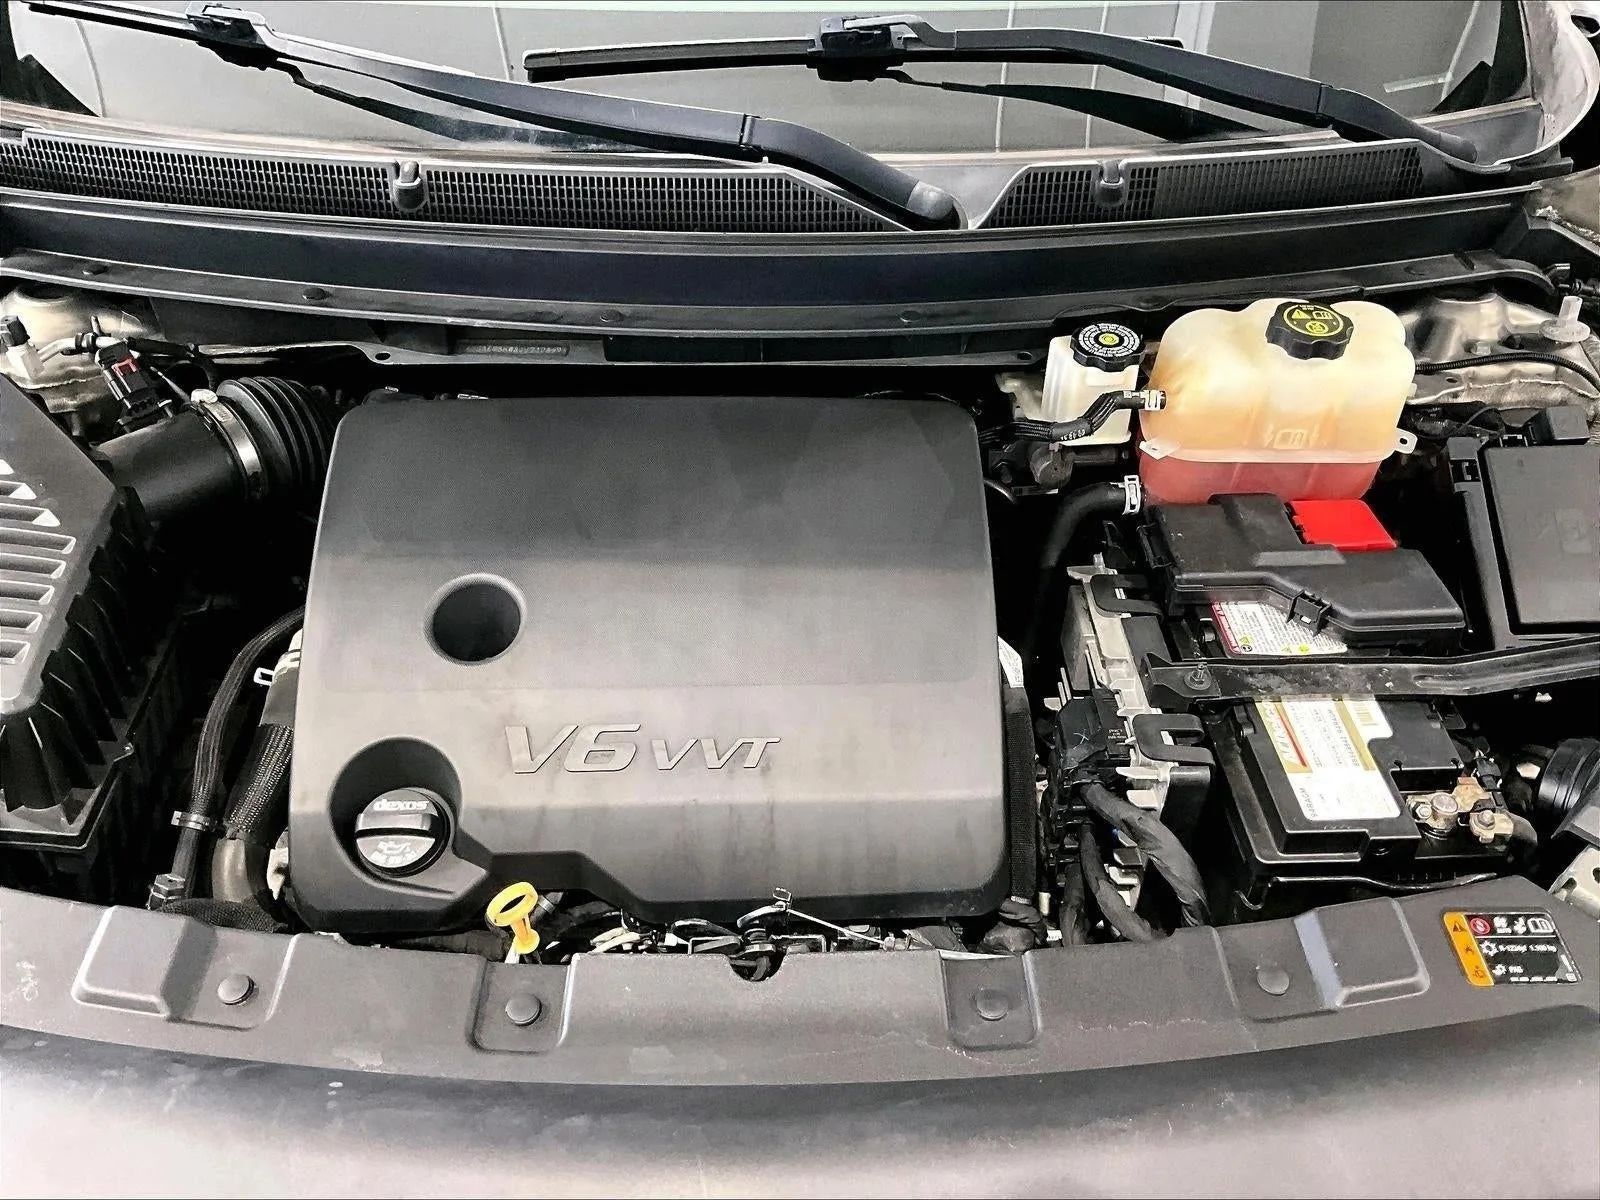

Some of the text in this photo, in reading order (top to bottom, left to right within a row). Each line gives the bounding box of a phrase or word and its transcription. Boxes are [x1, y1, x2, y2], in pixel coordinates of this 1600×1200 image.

[505, 723, 781, 774] V6 VVT
[373, 798, 429, 812] dexos
